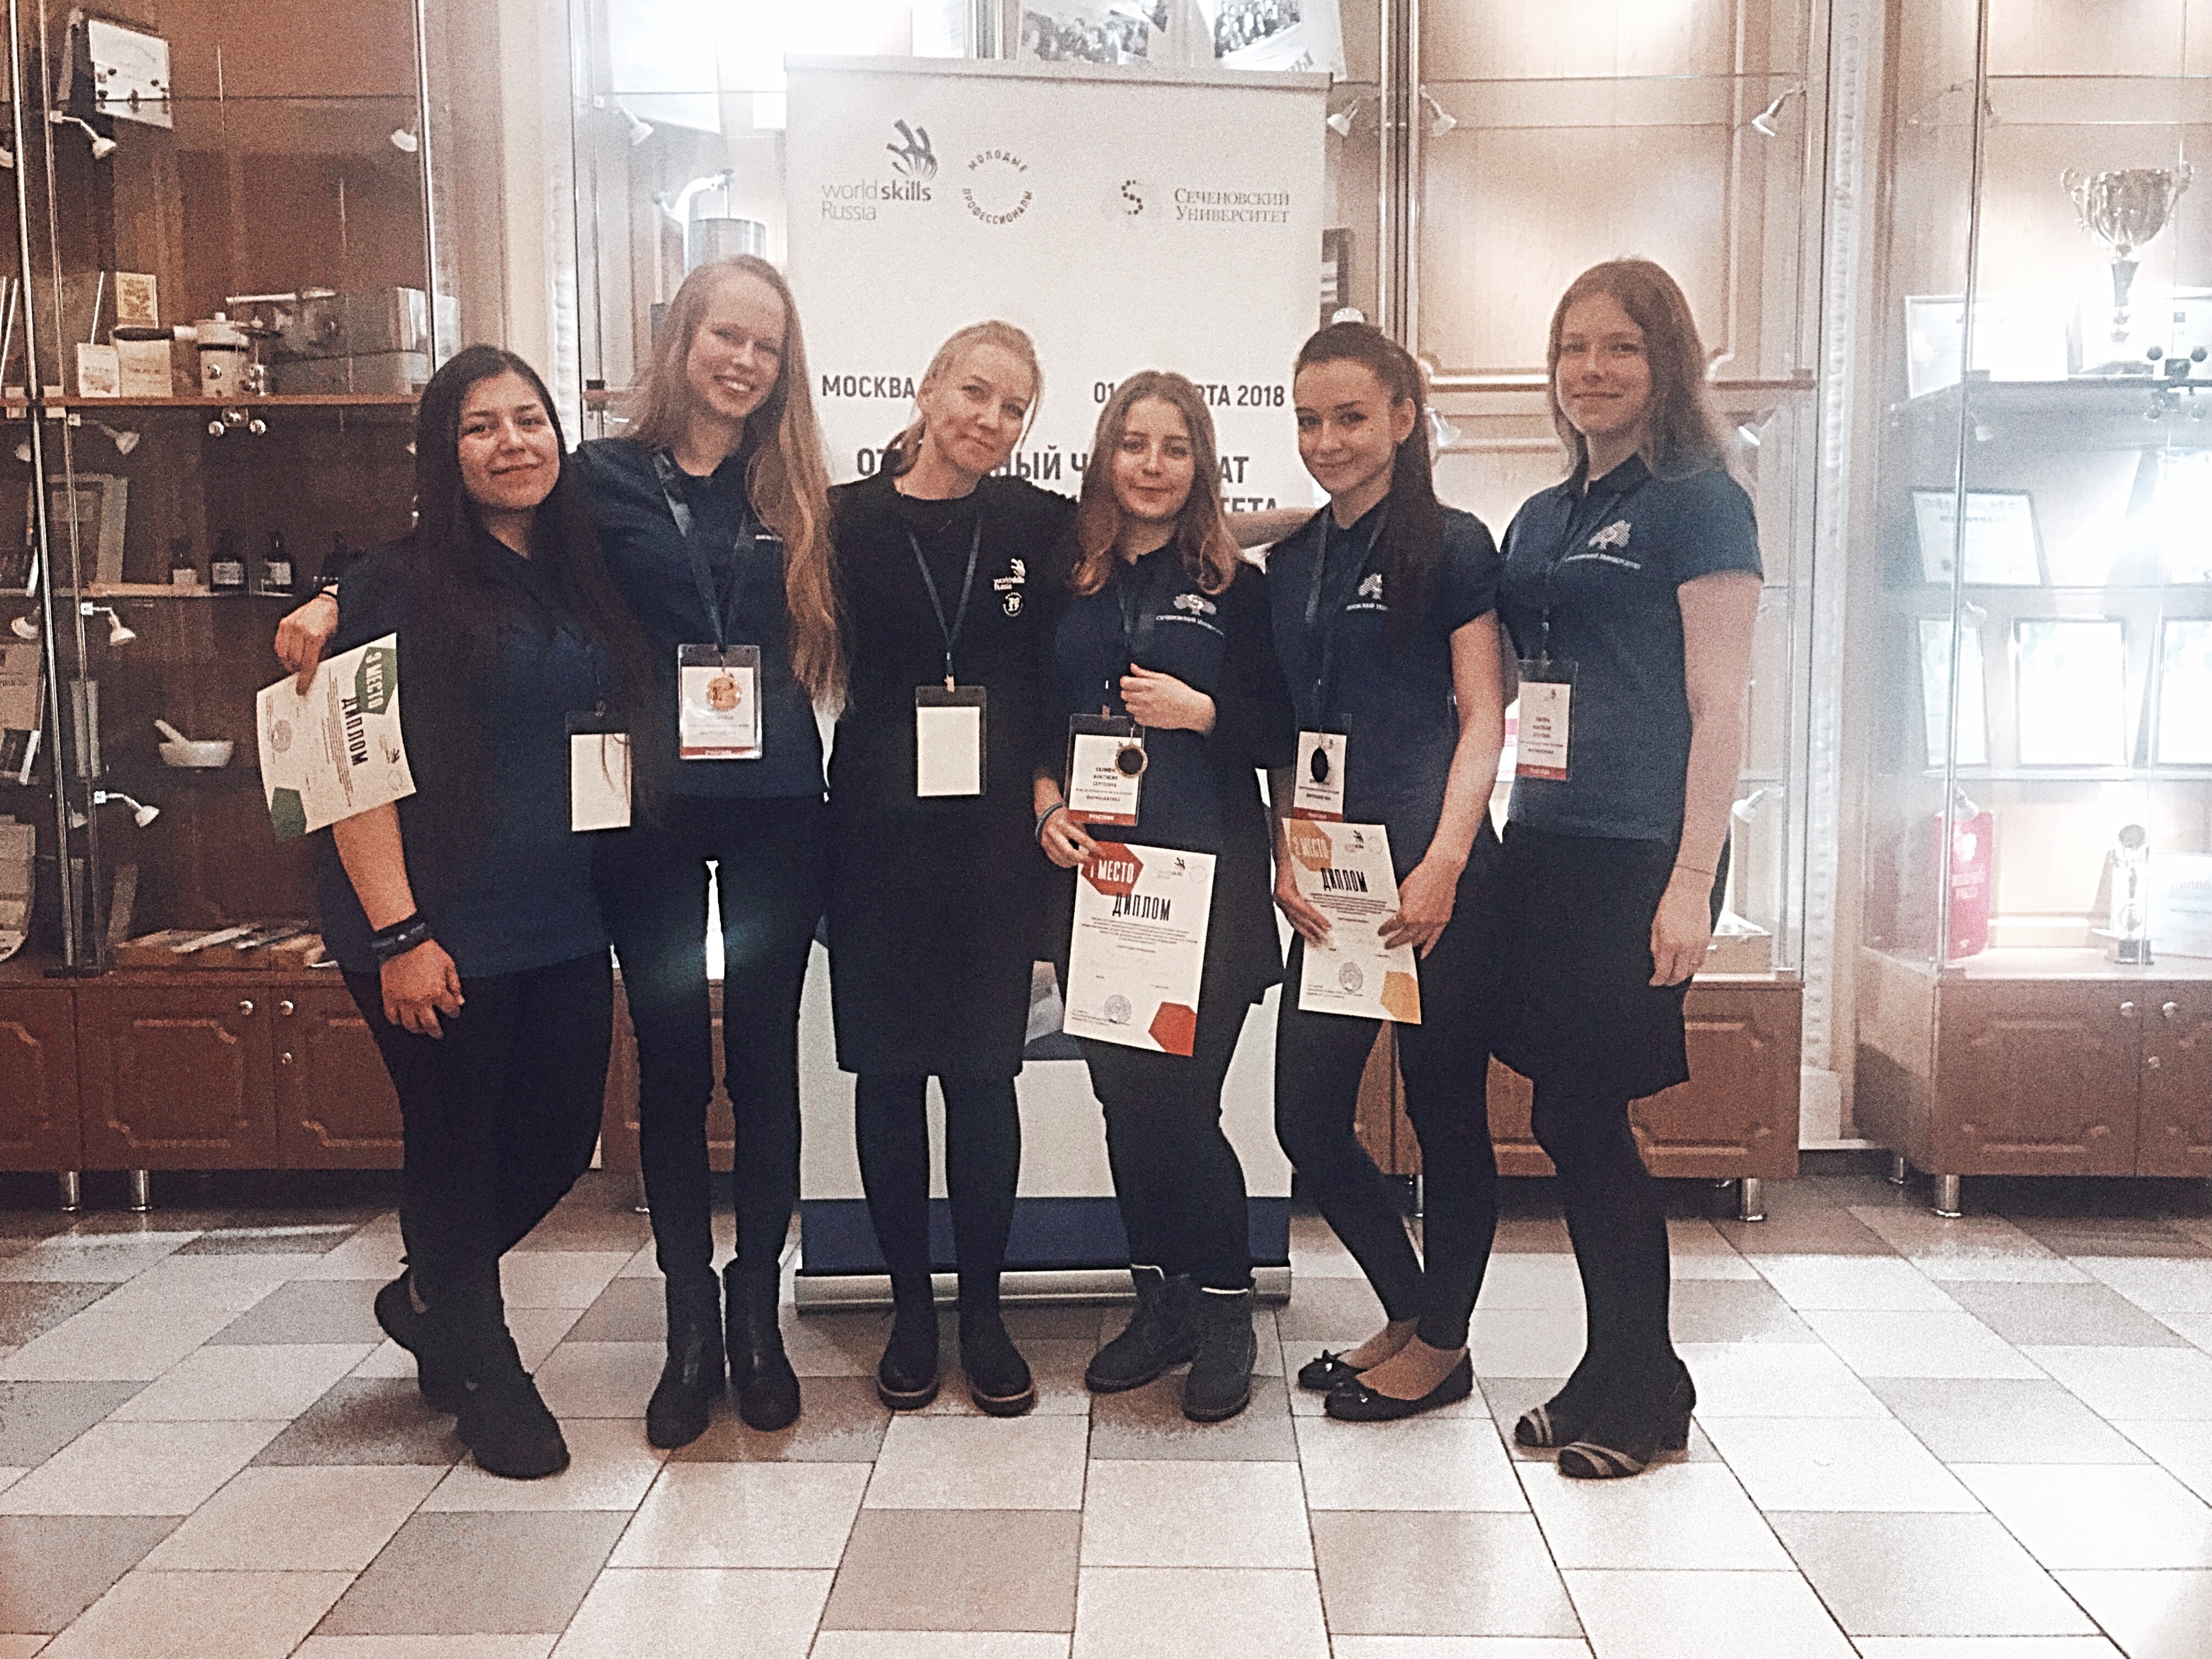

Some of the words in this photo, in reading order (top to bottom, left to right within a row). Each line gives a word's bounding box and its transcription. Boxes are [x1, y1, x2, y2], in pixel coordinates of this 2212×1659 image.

[968, 149, 1028, 173] МОЛОДЫЕ
[822, 200, 877, 221] Russia
[963, 188, 1033, 225] ПРОФЕССИОНАЛЫ
[822, 375, 916, 399] МОСКВА
[1237, 385, 1285, 407] 2018
[365, 652, 382, 664] 3
[366, 663, 383, 709] МЕСТО
[342, 696, 368, 766] ДИПЛОМ
[1293, 836, 1302, 856] 2
[1300, 837, 1330, 859] МЕСТО
[1098, 859, 1135, 884] МЕСТО
[1320, 867, 1368, 893] ДИПЛОМ
[1112, 891, 1171, 921] ДИПЛОМ
